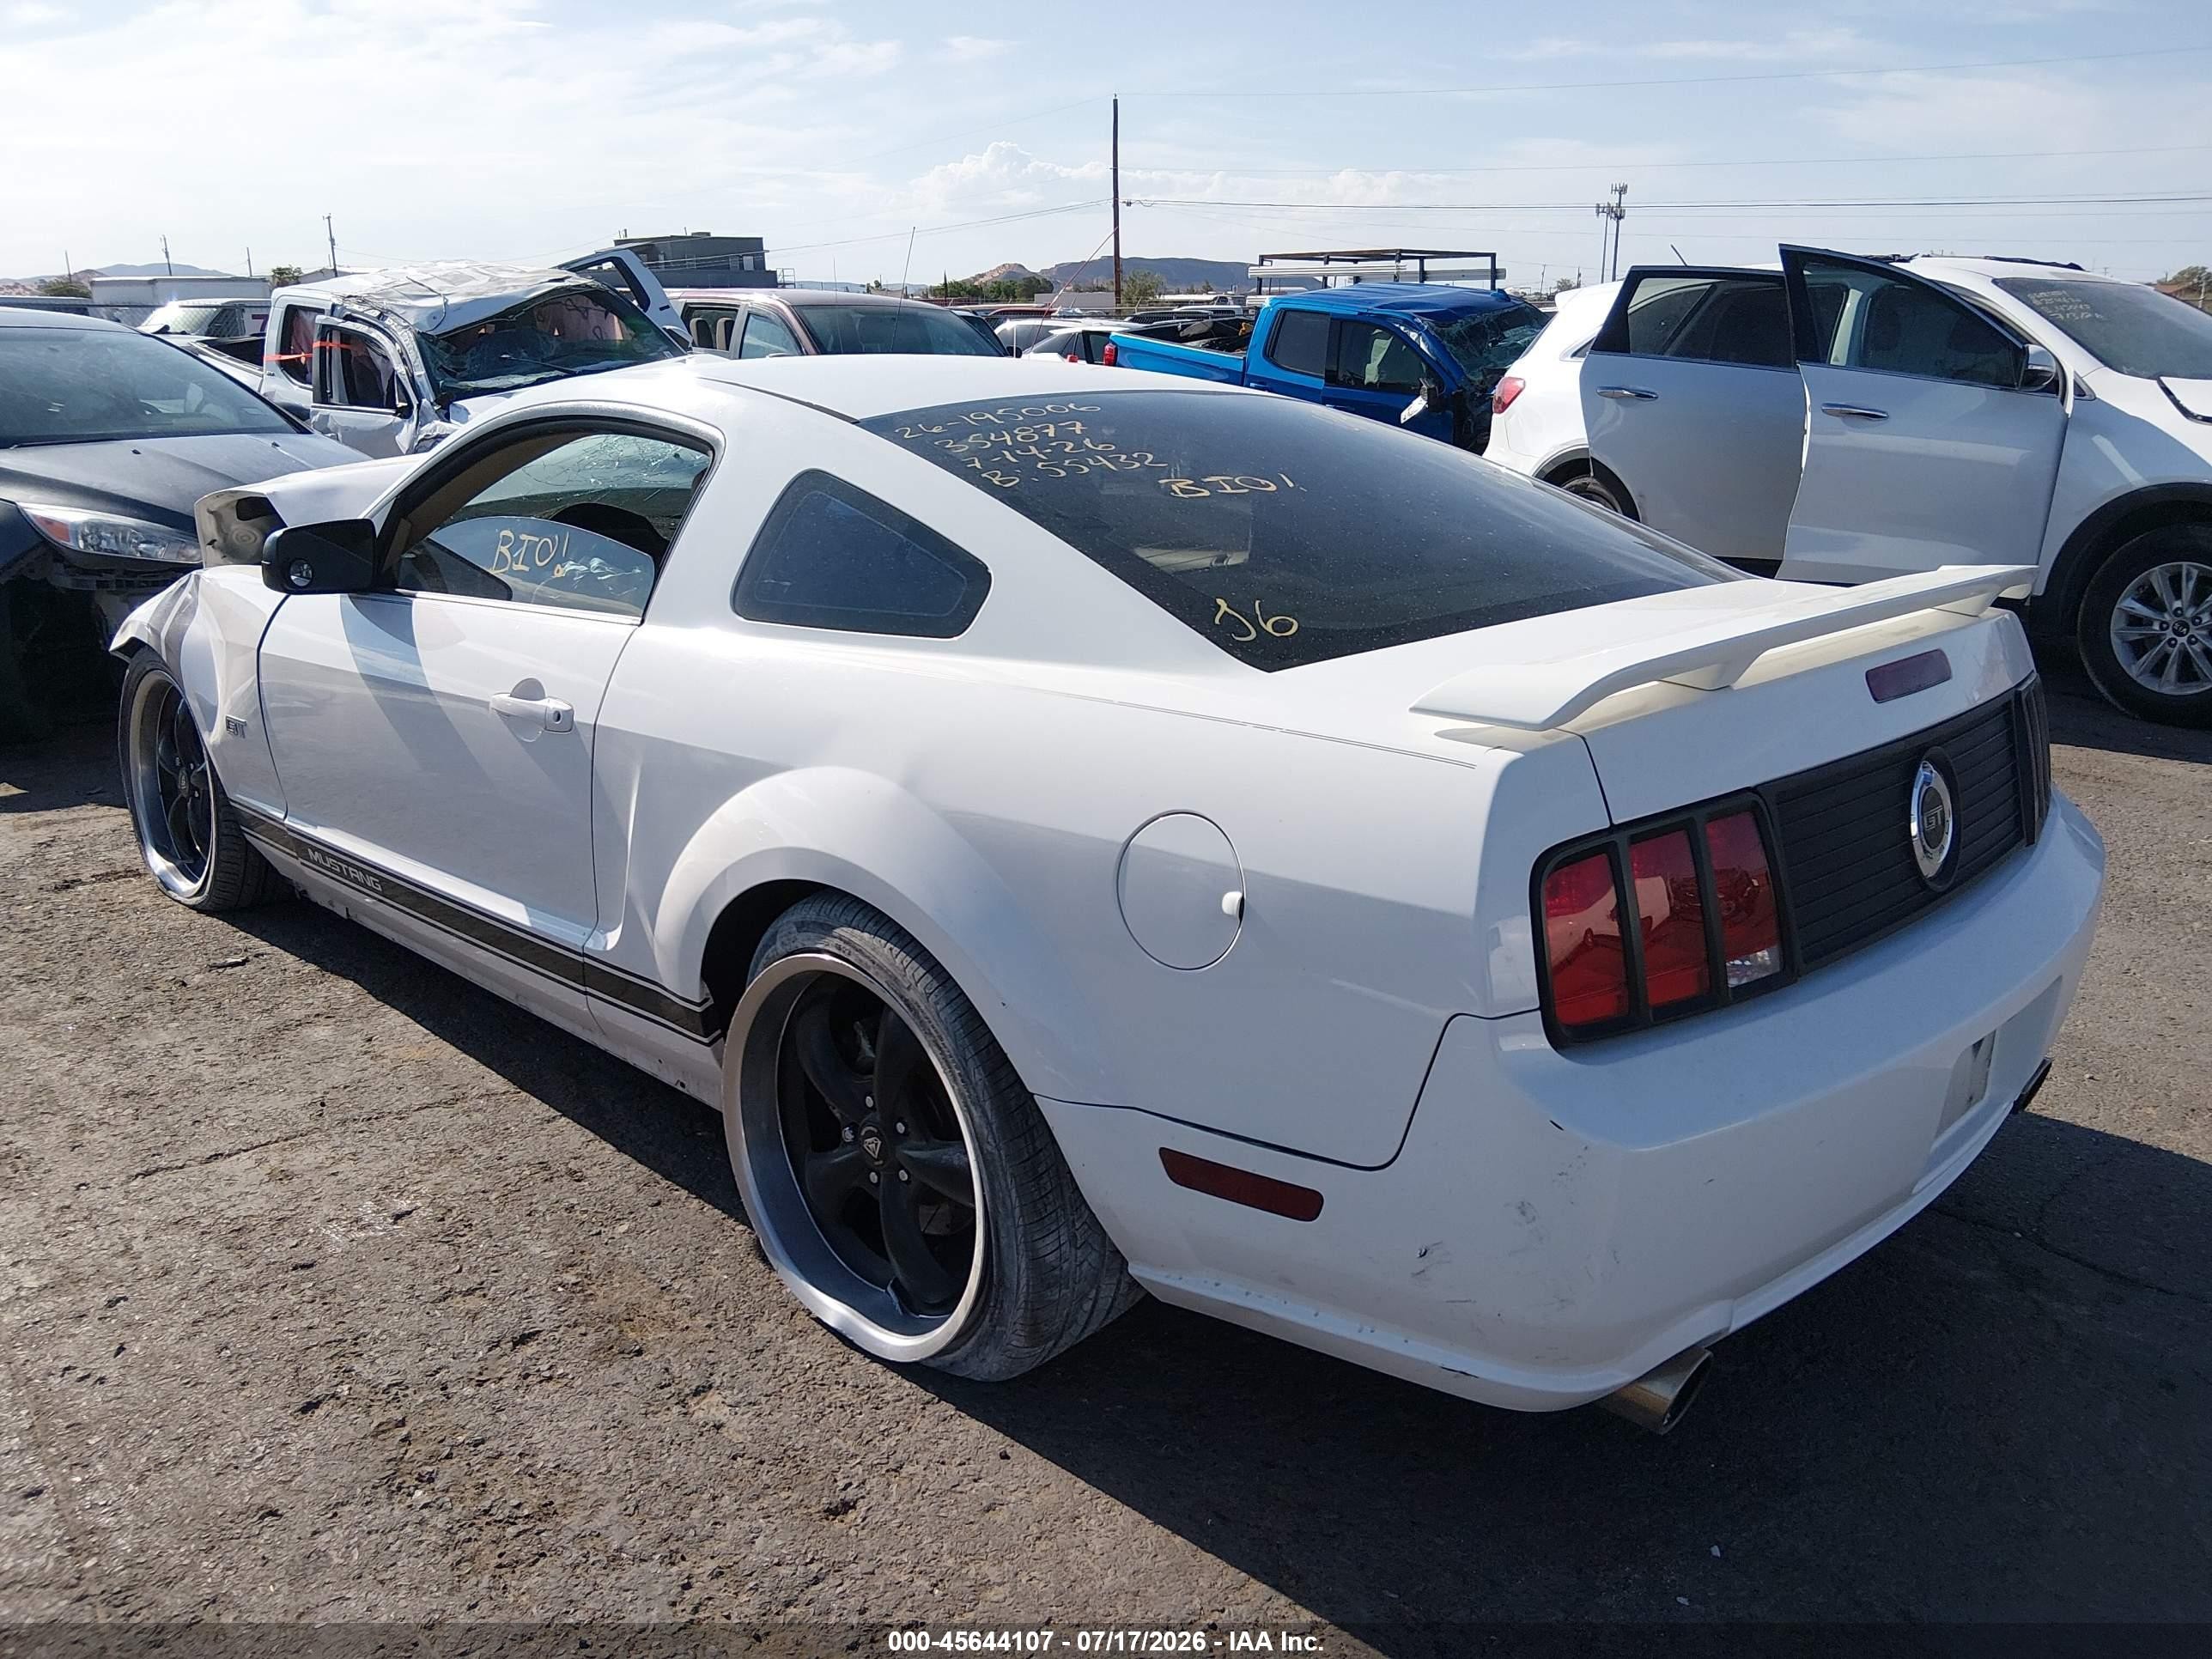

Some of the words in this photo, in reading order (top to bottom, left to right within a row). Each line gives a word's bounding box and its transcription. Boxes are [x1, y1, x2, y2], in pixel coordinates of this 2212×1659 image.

[895, 404, 1102, 439] 26-195006
[934, 421, 1087, 453] 354877
[962, 438, 1116, 470] 7-14-26
[1923, 805, 1943, 831] GT
[307, 848, 383, 892] MUSTANG
